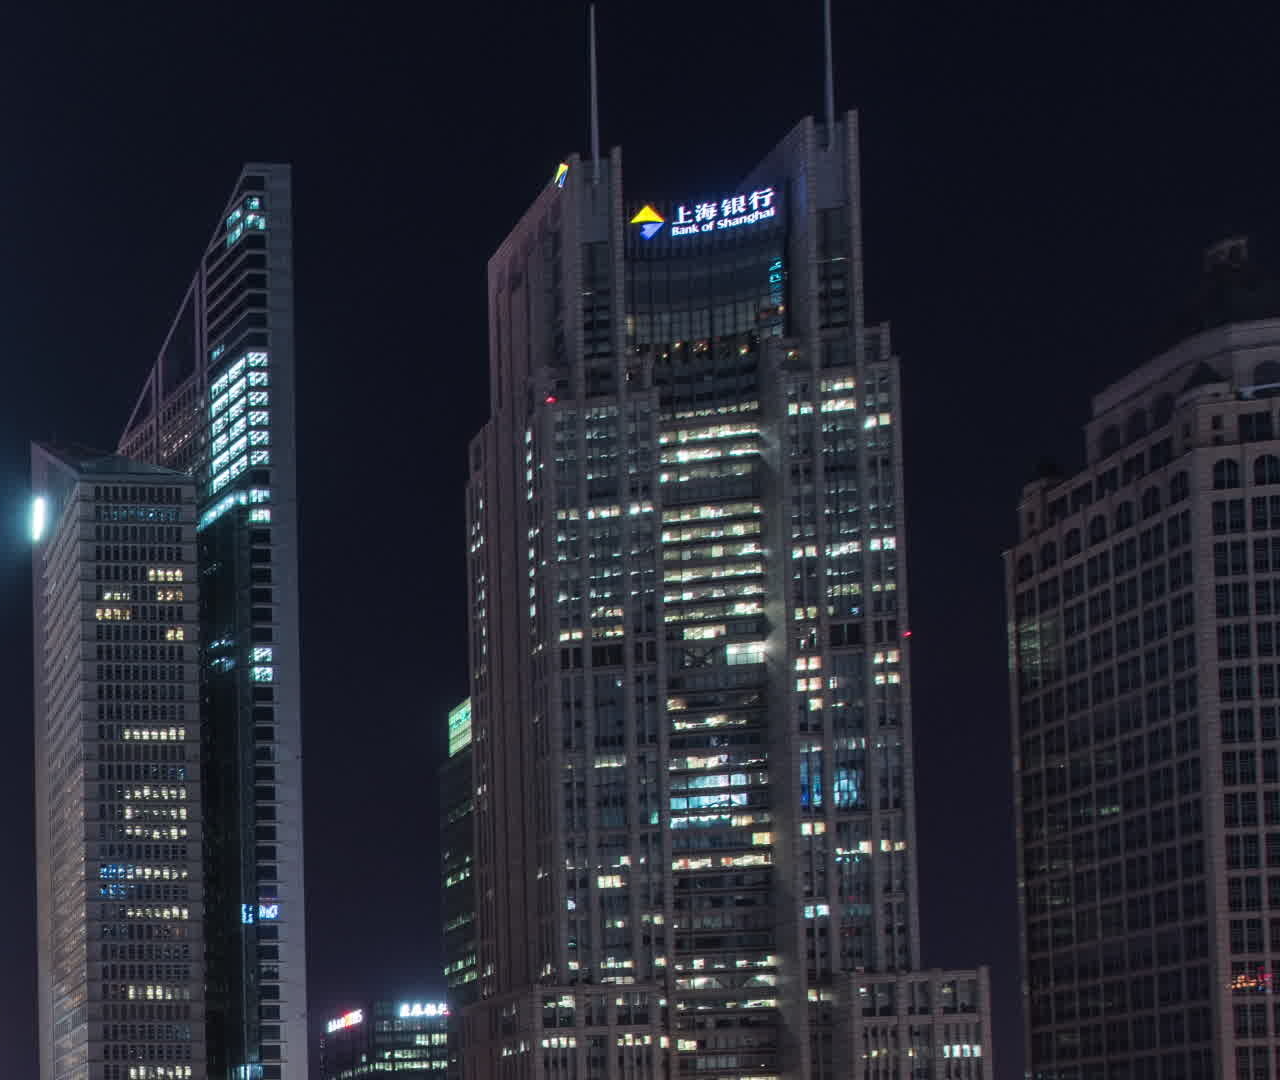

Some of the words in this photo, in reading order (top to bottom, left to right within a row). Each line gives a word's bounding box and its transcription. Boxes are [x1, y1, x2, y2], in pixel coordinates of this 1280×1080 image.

[672, 188, 775, 225] 上海银行
[672, 224, 699, 236] Bank
[702, 221, 715, 232] of
[717, 207, 775, 229] Shanghai
